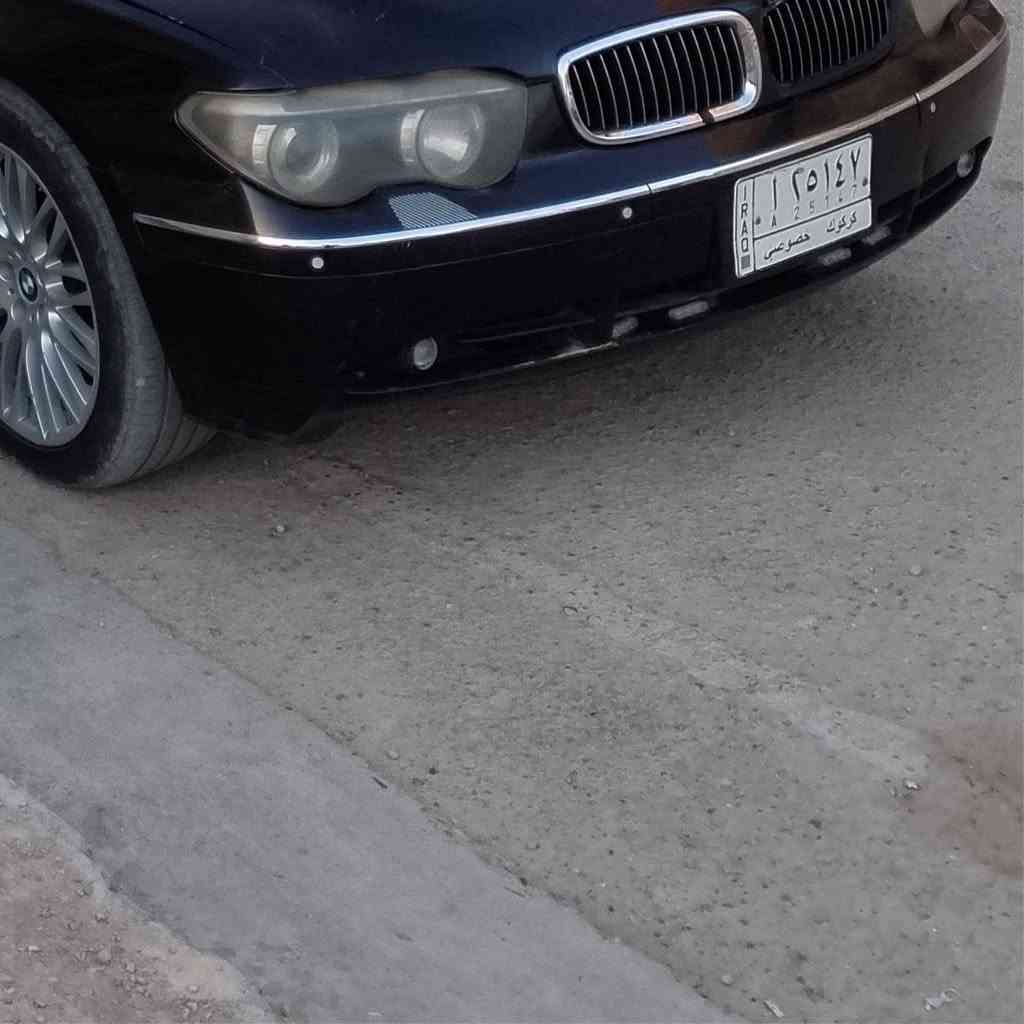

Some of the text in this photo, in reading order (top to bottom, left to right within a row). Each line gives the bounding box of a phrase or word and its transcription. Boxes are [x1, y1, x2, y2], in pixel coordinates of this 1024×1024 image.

[791, 147, 863, 203] ٢٥١٤٧
[739, 184, 749, 253] IRAQ
[825, 210, 858, 234] كركوك
